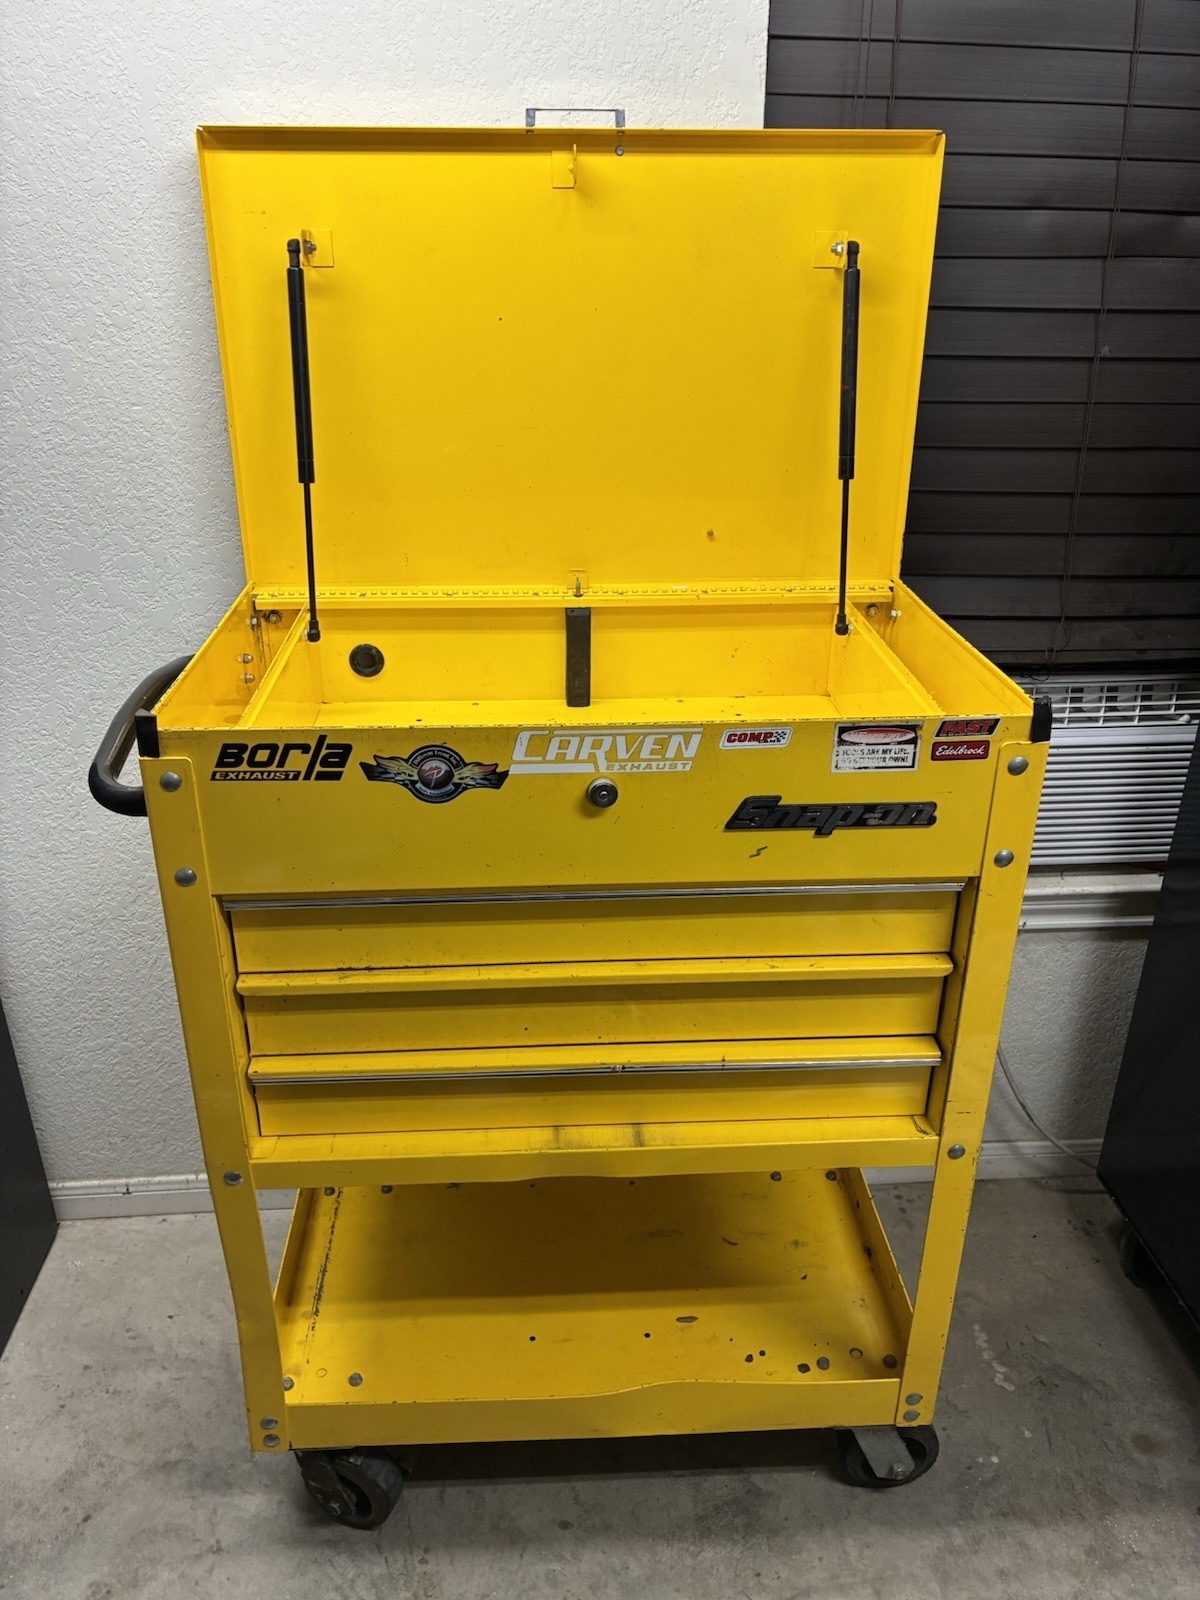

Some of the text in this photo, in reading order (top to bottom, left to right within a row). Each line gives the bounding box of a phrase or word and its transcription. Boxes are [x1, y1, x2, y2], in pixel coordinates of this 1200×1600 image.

[941, 720, 994, 734] FAST
[726, 732, 774, 743] COMP
[511, 728, 703, 771] CARVEN
[881, 747, 893, 755] MY
[935, 744, 986, 756] Edelbrock
[606, 762, 690, 771] EXHAUST
[214, 771, 298, 780] EXHAUST
[725, 795, 937, 834] Snap-on
